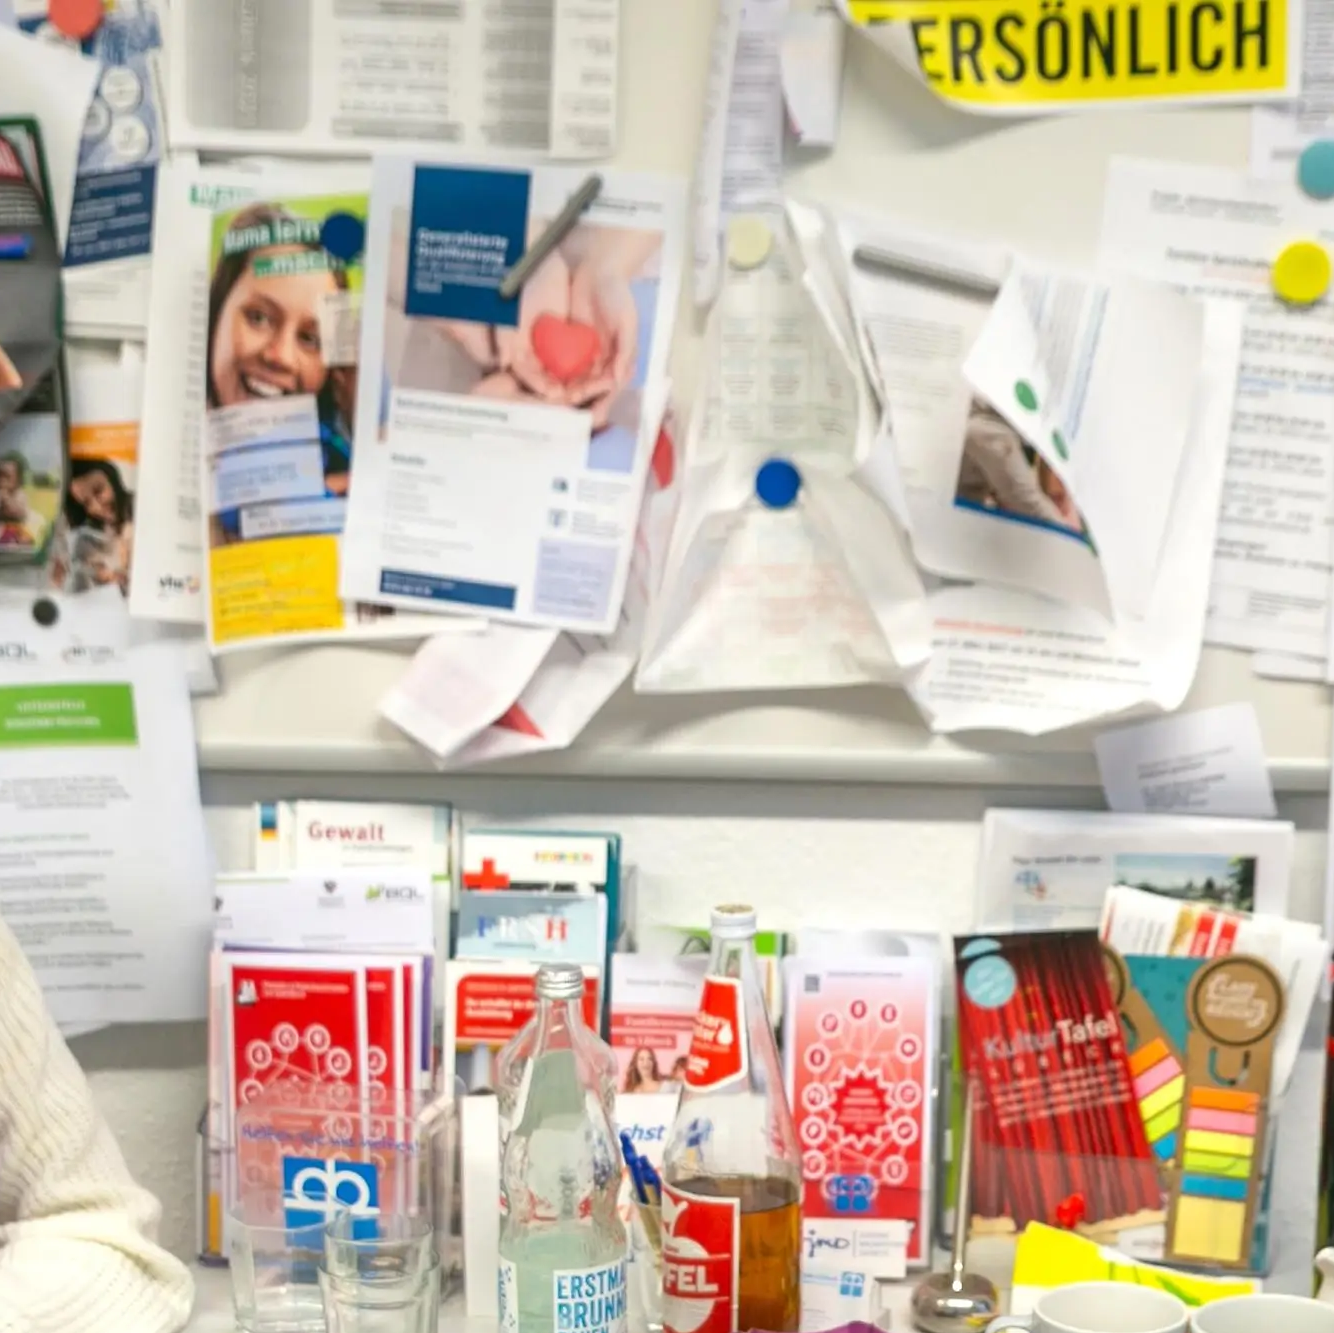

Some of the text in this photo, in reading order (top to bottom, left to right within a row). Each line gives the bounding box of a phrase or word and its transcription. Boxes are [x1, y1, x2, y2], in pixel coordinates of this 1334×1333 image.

[910, 0, 1269, 84] ERSÖNLICH
[308, 819, 385, 842] Gewalt
[983, 1010, 1118, 1060] KulturTafel
[557, 1263, 628, 1300] ERSTMA
[665, 1262, 719, 1294] FEL
[557, 1290, 628, 1329] BRUNN
